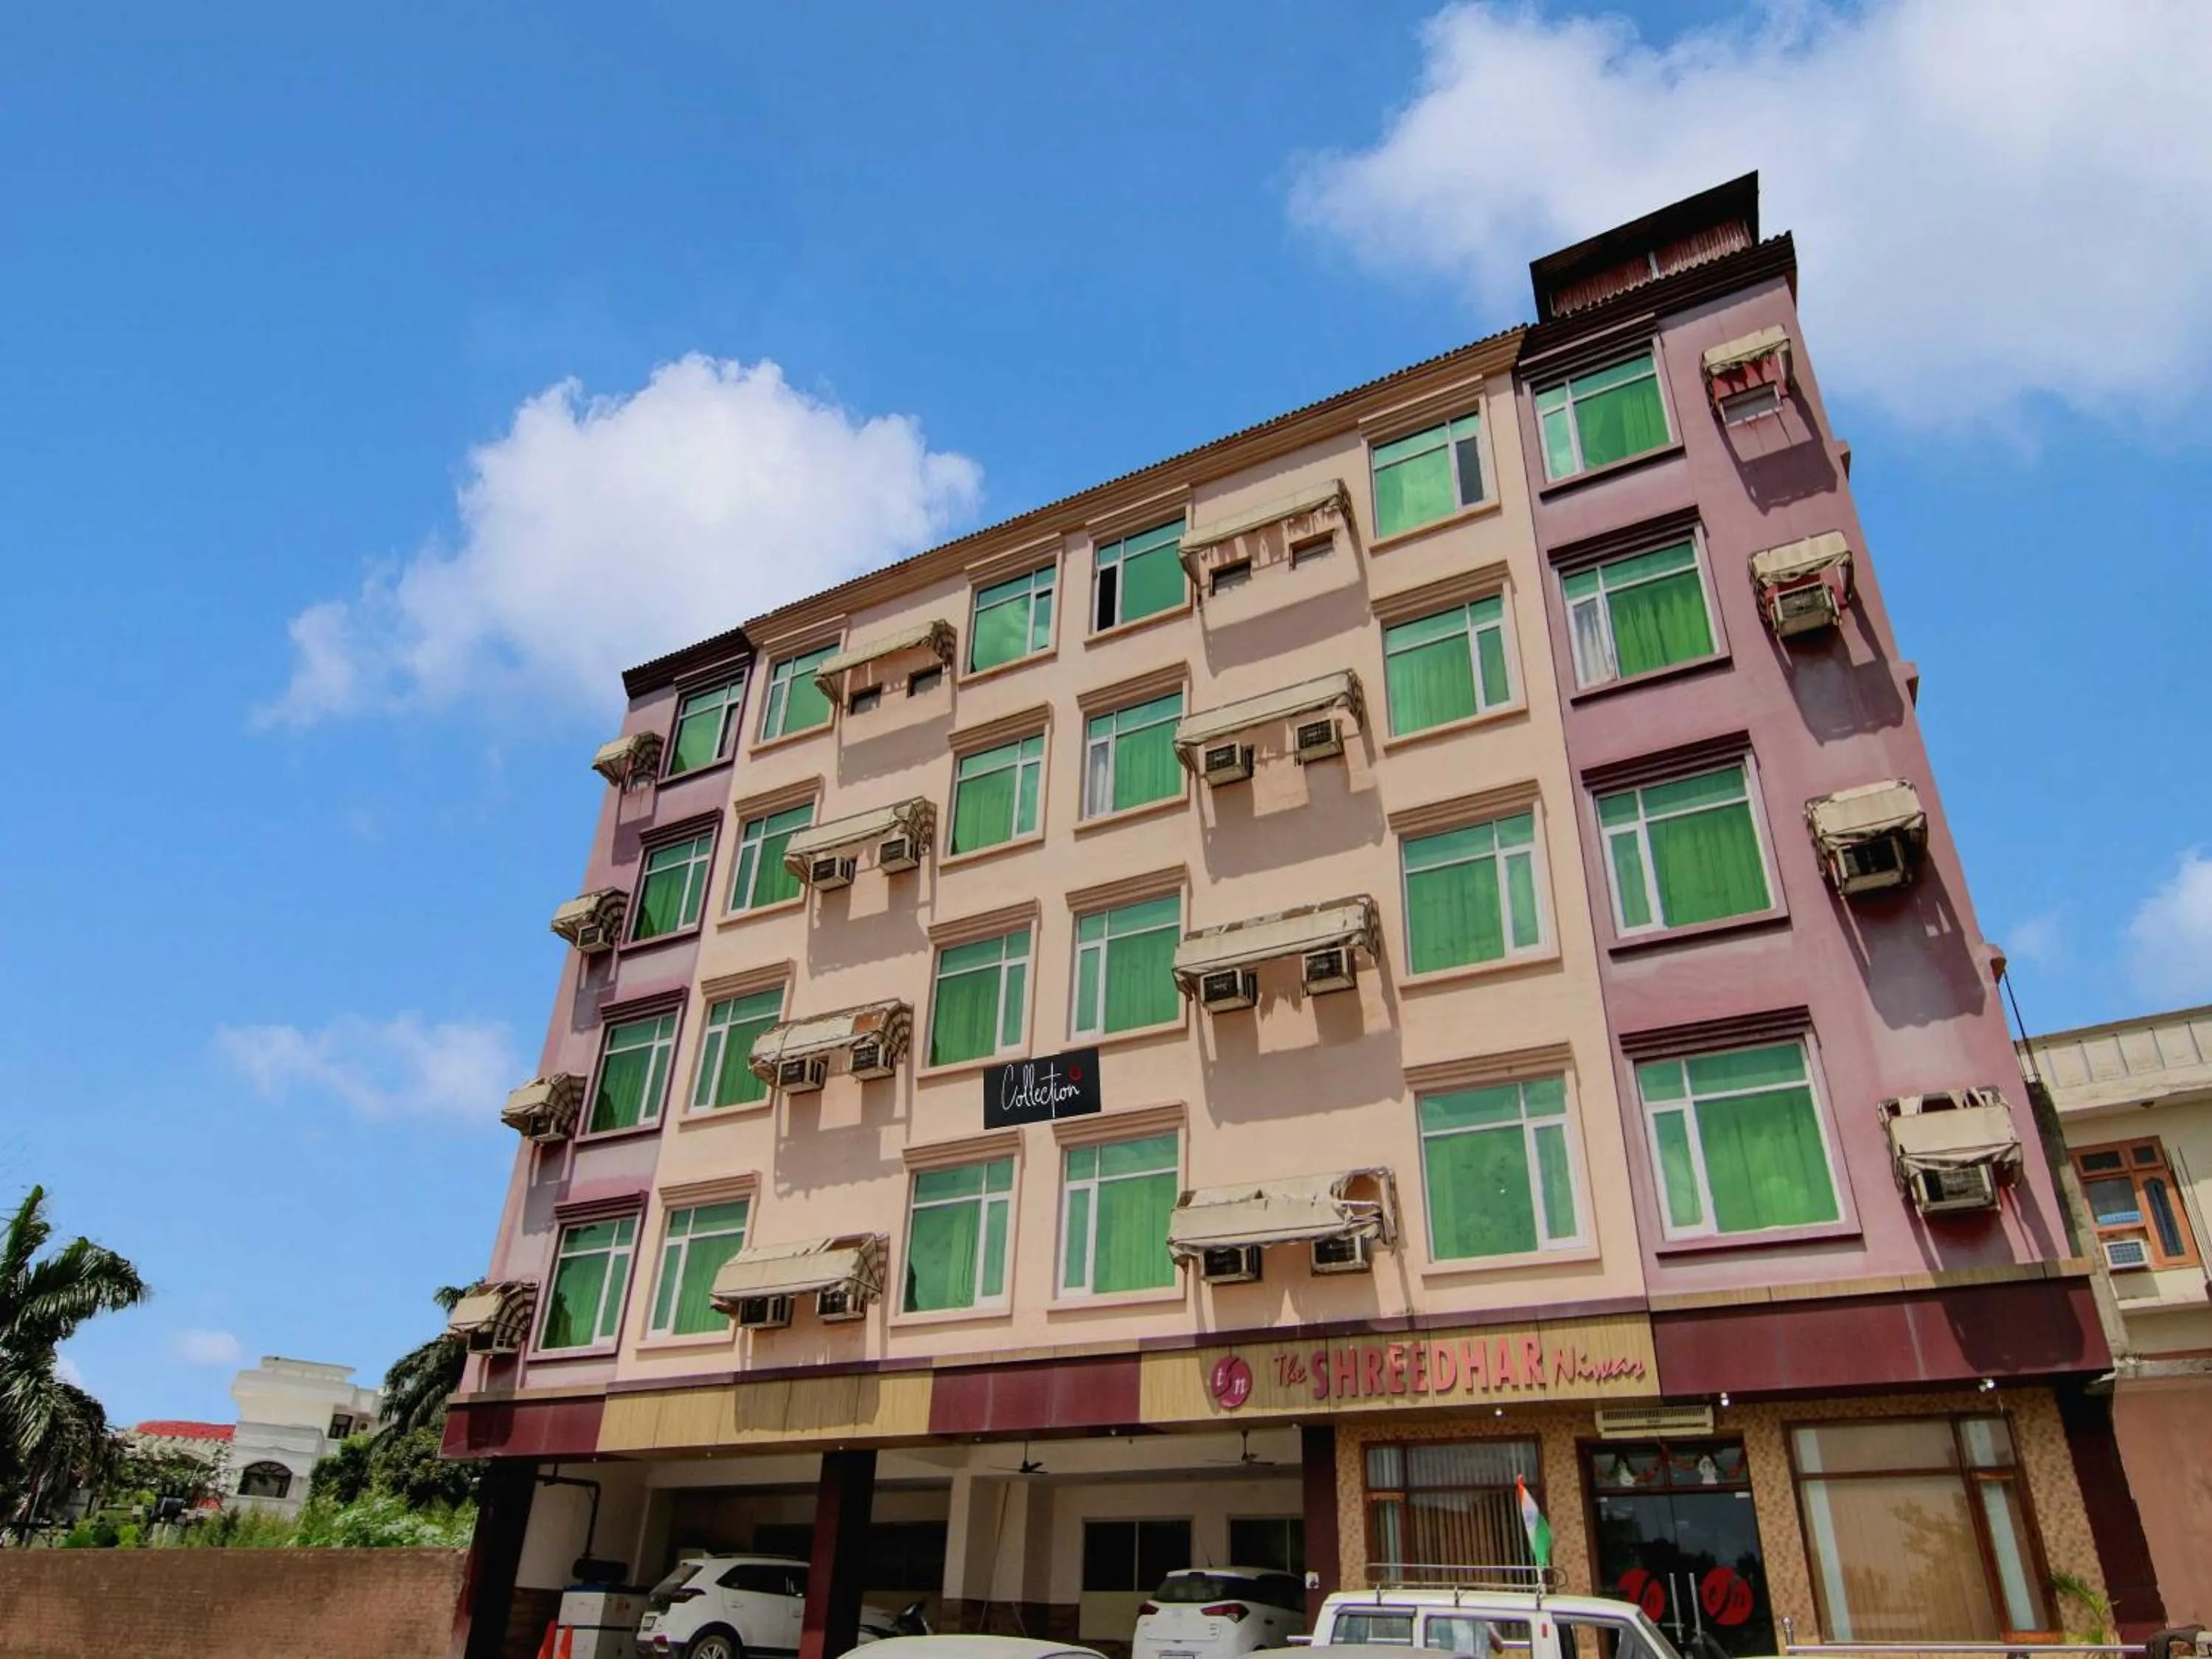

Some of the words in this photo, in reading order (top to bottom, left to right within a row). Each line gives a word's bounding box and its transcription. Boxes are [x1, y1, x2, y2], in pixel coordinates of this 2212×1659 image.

[1001, 1062, 1079, 1119] Collection
[1274, 1352, 1307, 1387] The
[1311, 1334, 1547, 1399] SHREEDHAR
[1554, 1345, 1646, 1387] Niwas
